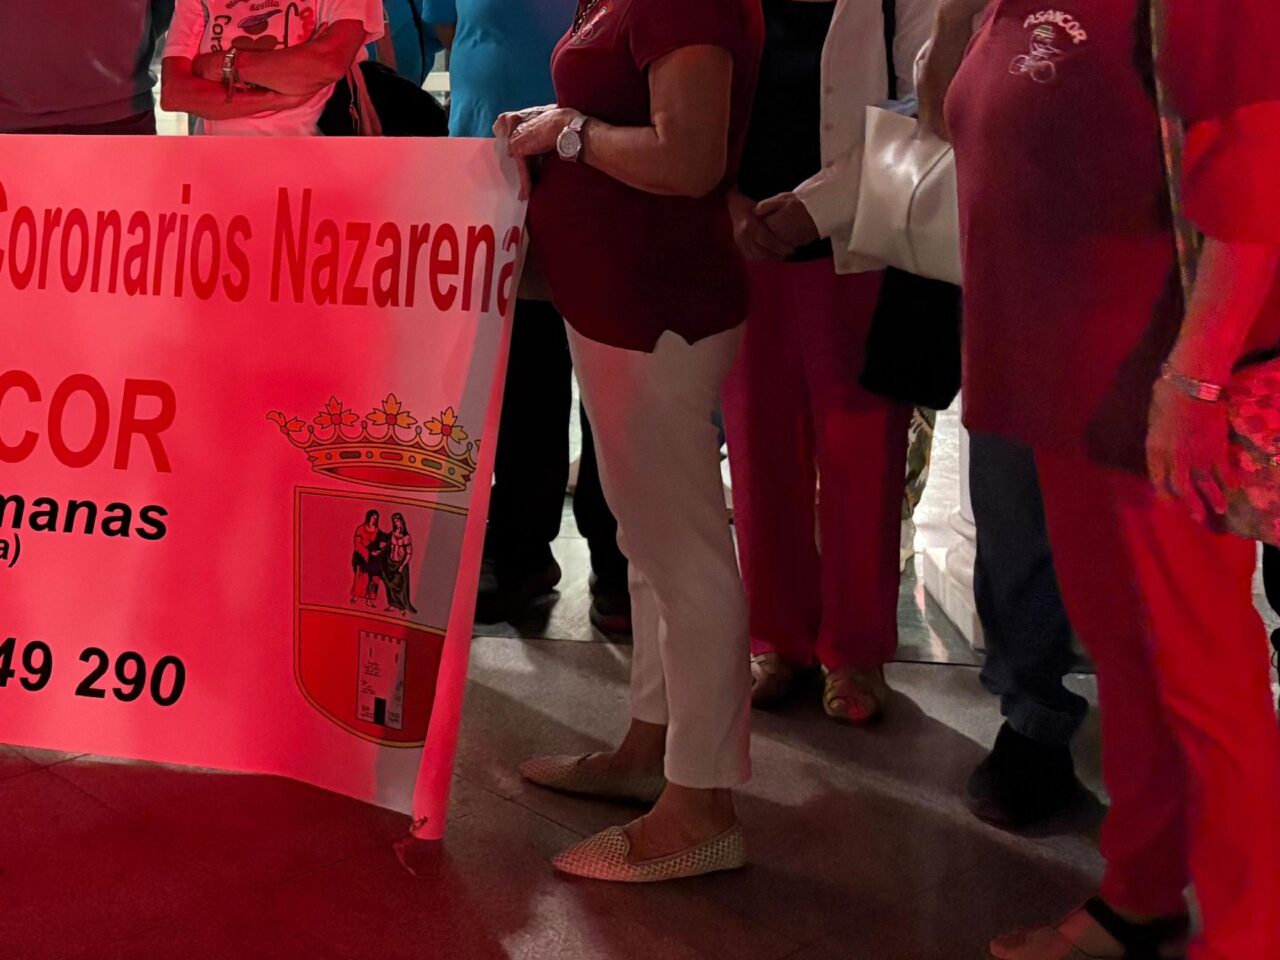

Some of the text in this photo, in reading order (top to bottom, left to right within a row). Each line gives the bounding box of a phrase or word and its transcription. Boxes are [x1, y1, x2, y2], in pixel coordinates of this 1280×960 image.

[1023, 9, 1087, 44] ASANCOR
[269, 186, 521, 318] Nazarena
[74, 646, 187, 708] 290
